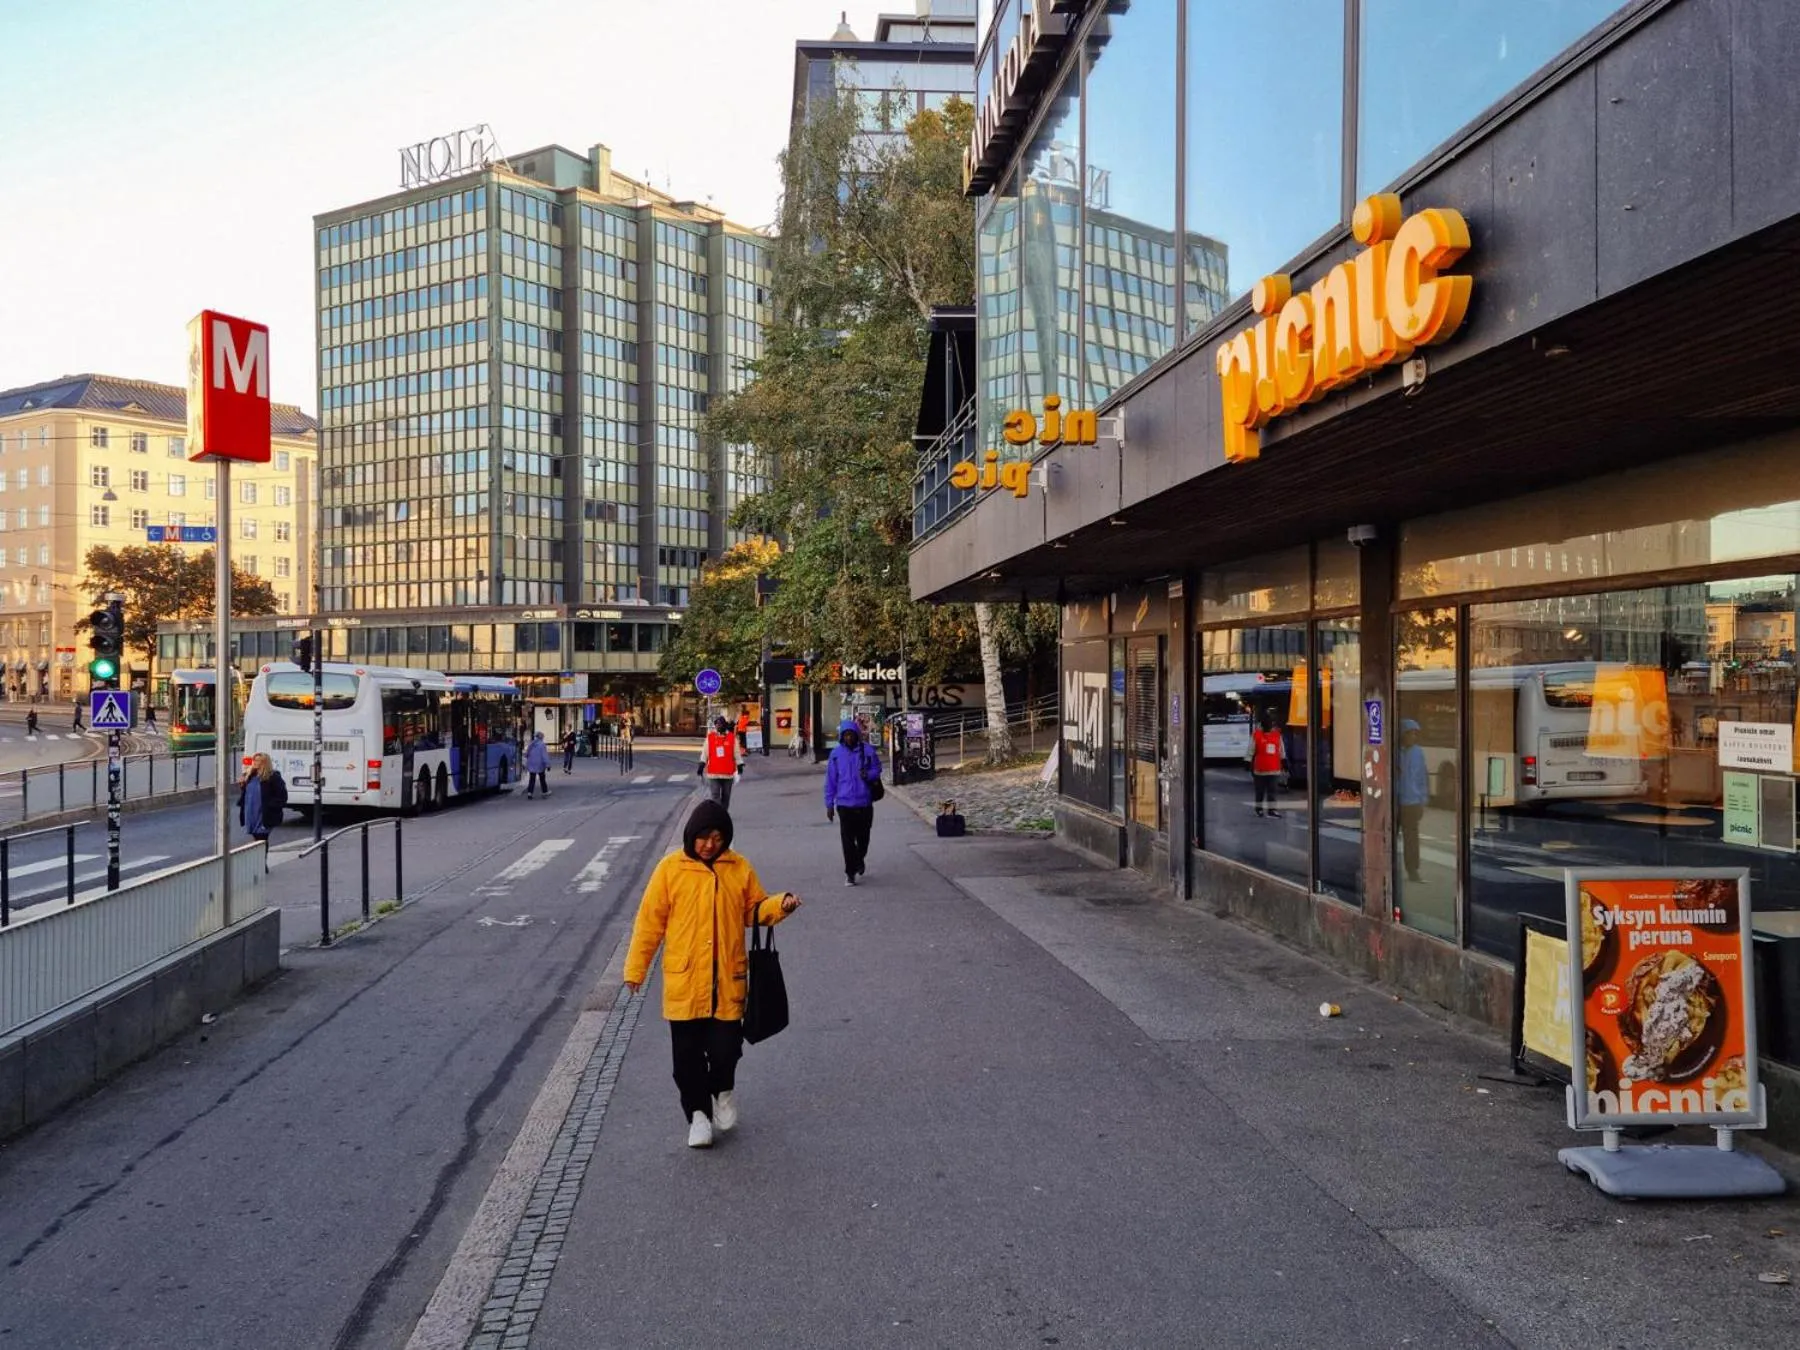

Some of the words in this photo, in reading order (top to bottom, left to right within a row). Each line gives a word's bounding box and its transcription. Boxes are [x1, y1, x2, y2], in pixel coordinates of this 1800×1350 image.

[1216, 192, 1473, 463] picnic
[212, 319, 268, 399] M
[164, 528, 181, 541] M
[1593, 904, 1656, 931] Syksyn
[1660, 903, 1727, 925] kuumin
[1629, 931, 1692, 950] peruna
